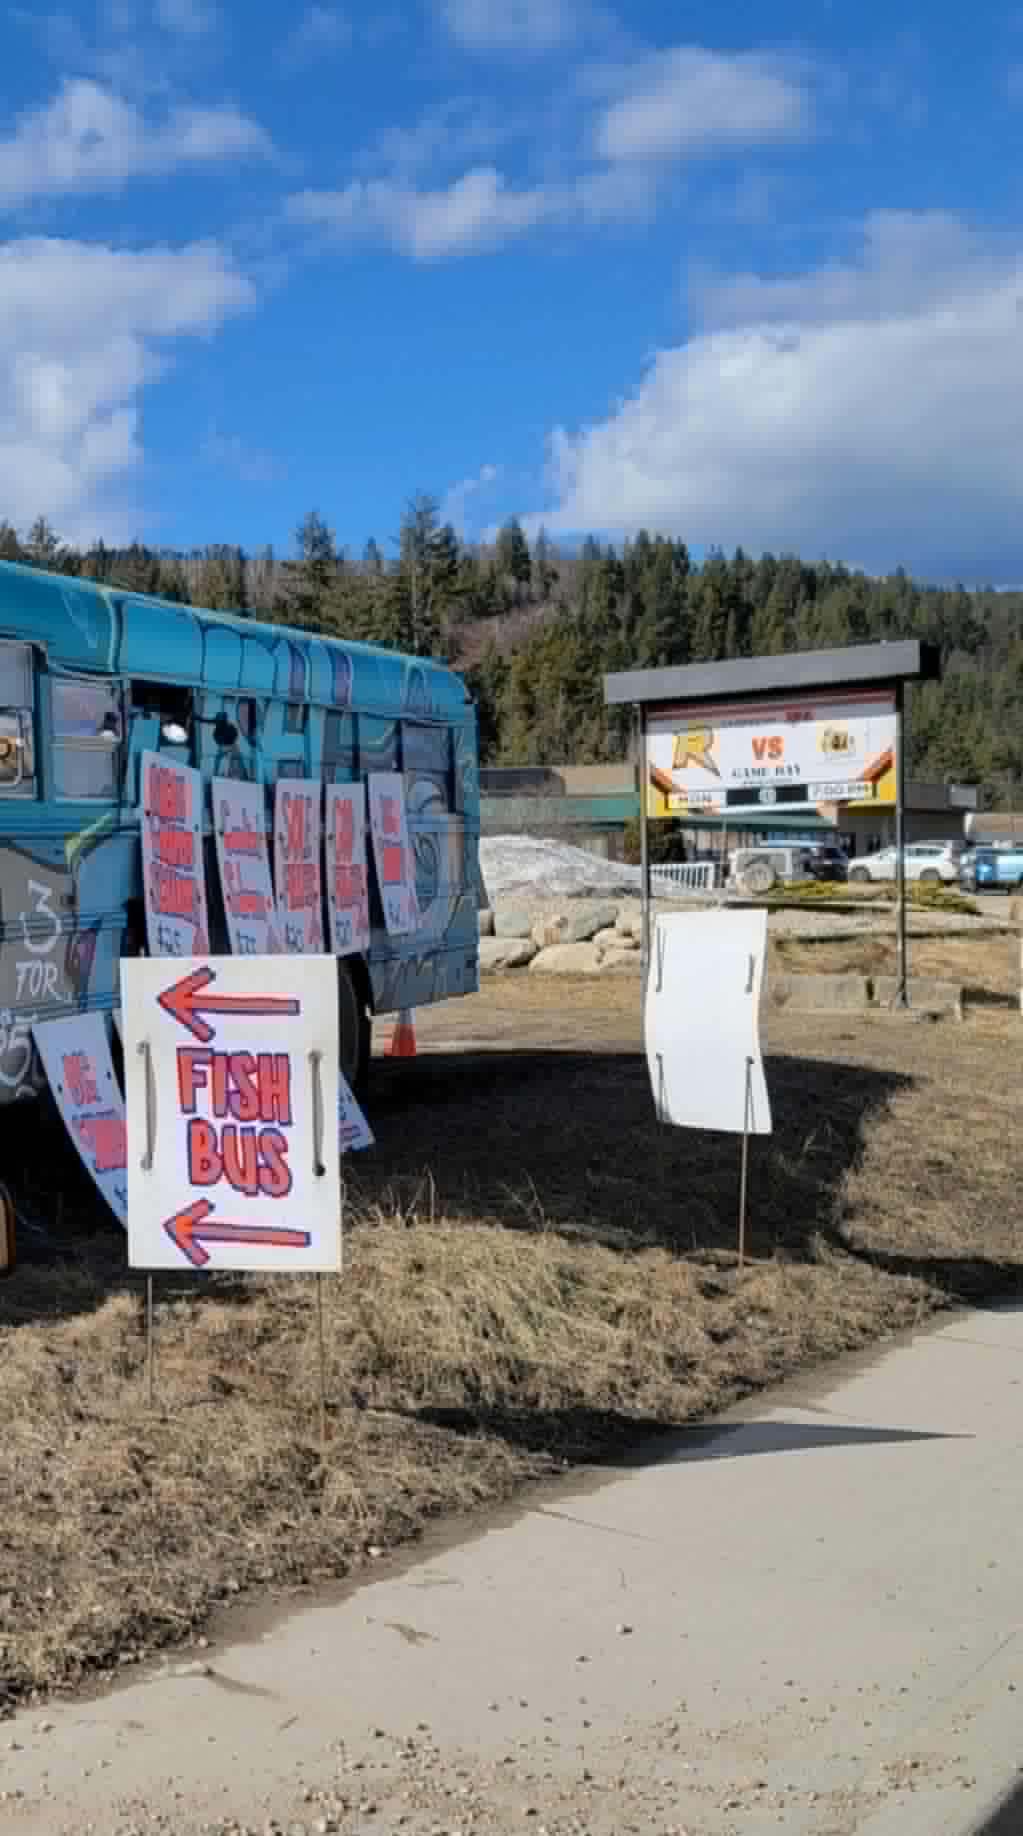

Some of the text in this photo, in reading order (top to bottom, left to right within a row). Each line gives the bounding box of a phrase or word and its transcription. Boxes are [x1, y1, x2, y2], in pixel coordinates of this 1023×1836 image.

[751, 736, 784, 761] VS
[19, 878, 62, 953] 3
[176, 1047, 294, 1127] FISH
[187, 1118, 293, 1199] BUS
